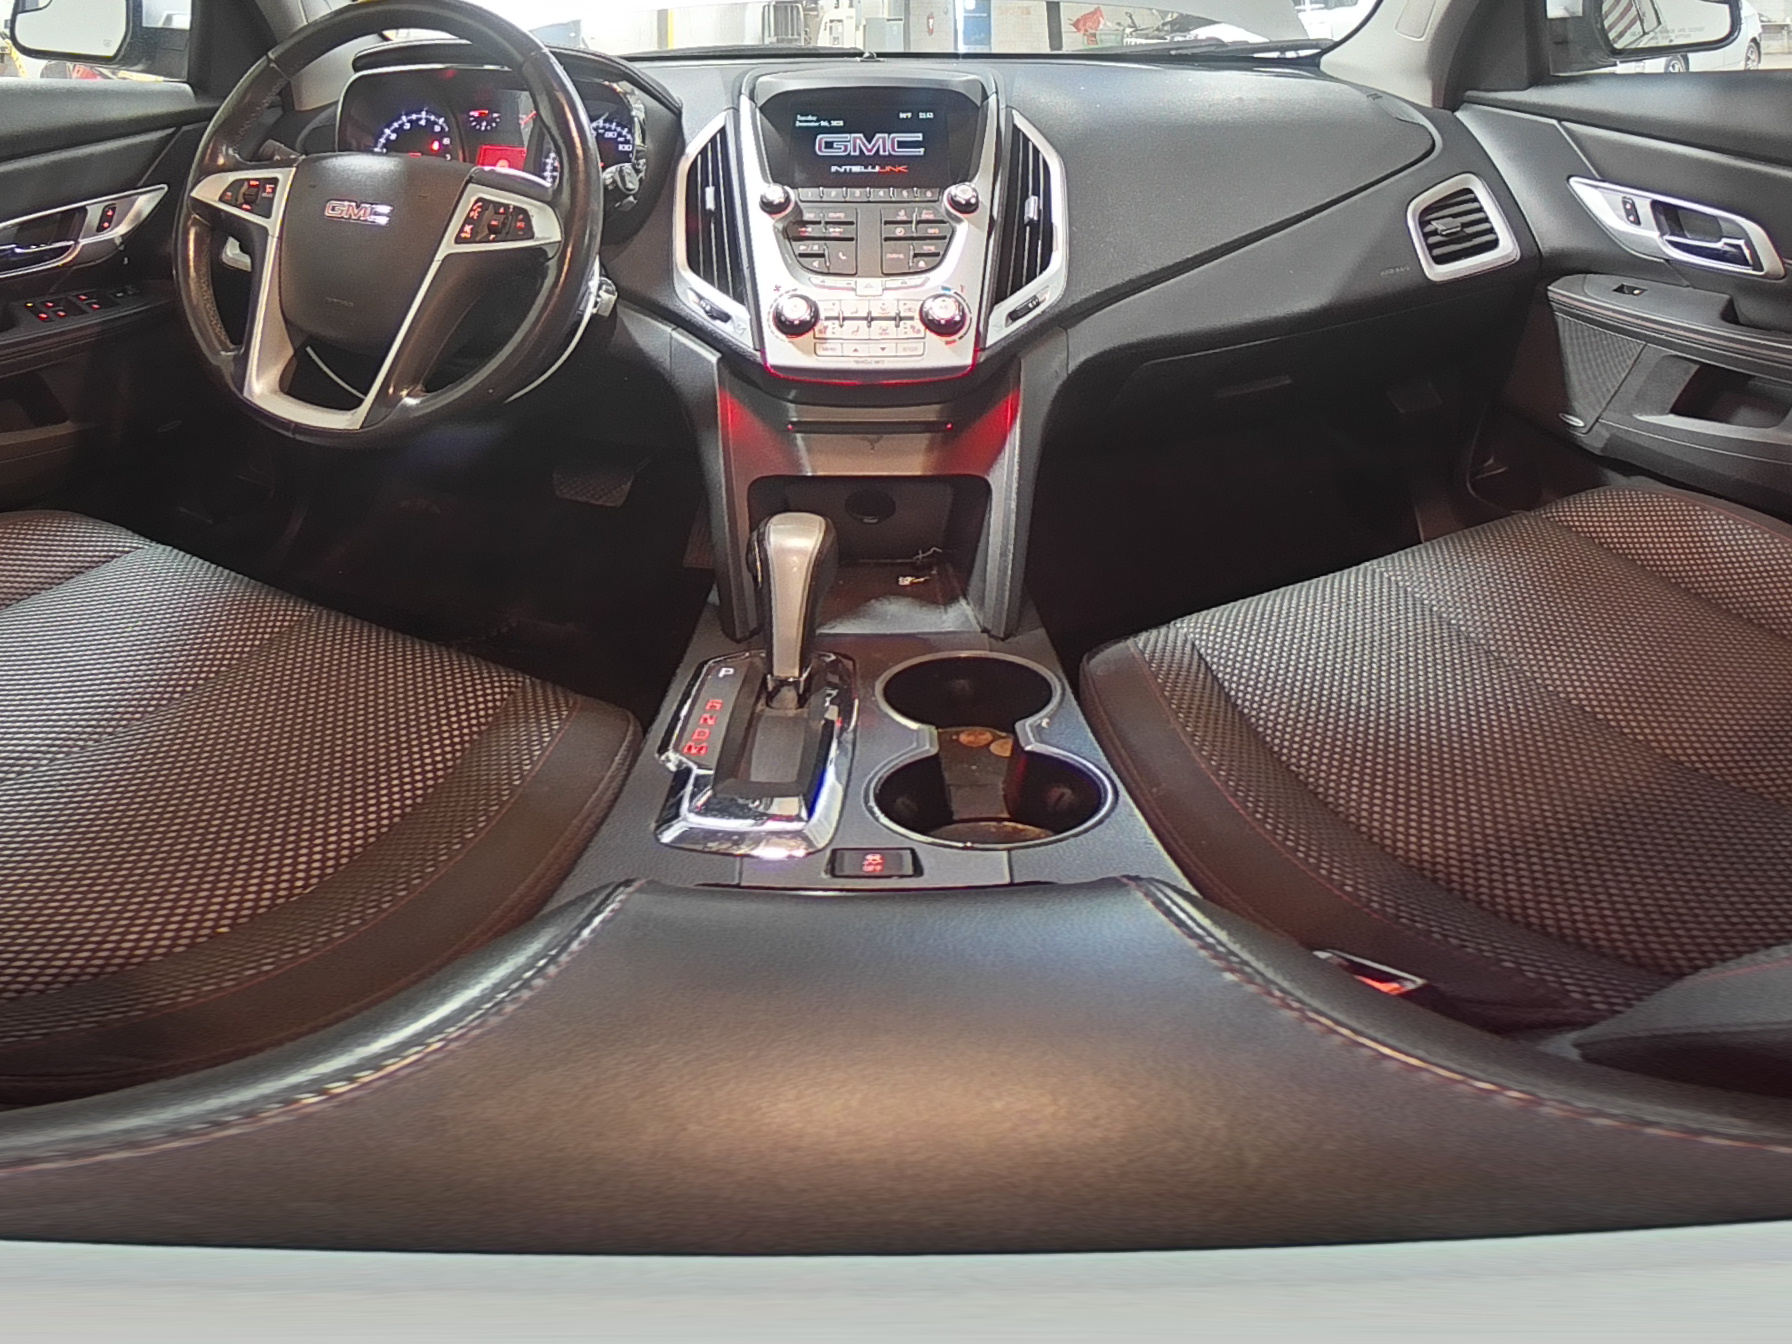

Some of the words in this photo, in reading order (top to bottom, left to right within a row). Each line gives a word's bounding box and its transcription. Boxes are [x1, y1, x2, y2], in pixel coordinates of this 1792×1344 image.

[815, 132, 926, 156] GMC
[324, 200, 394, 225] GMC
[718, 667, 735, 677] P
